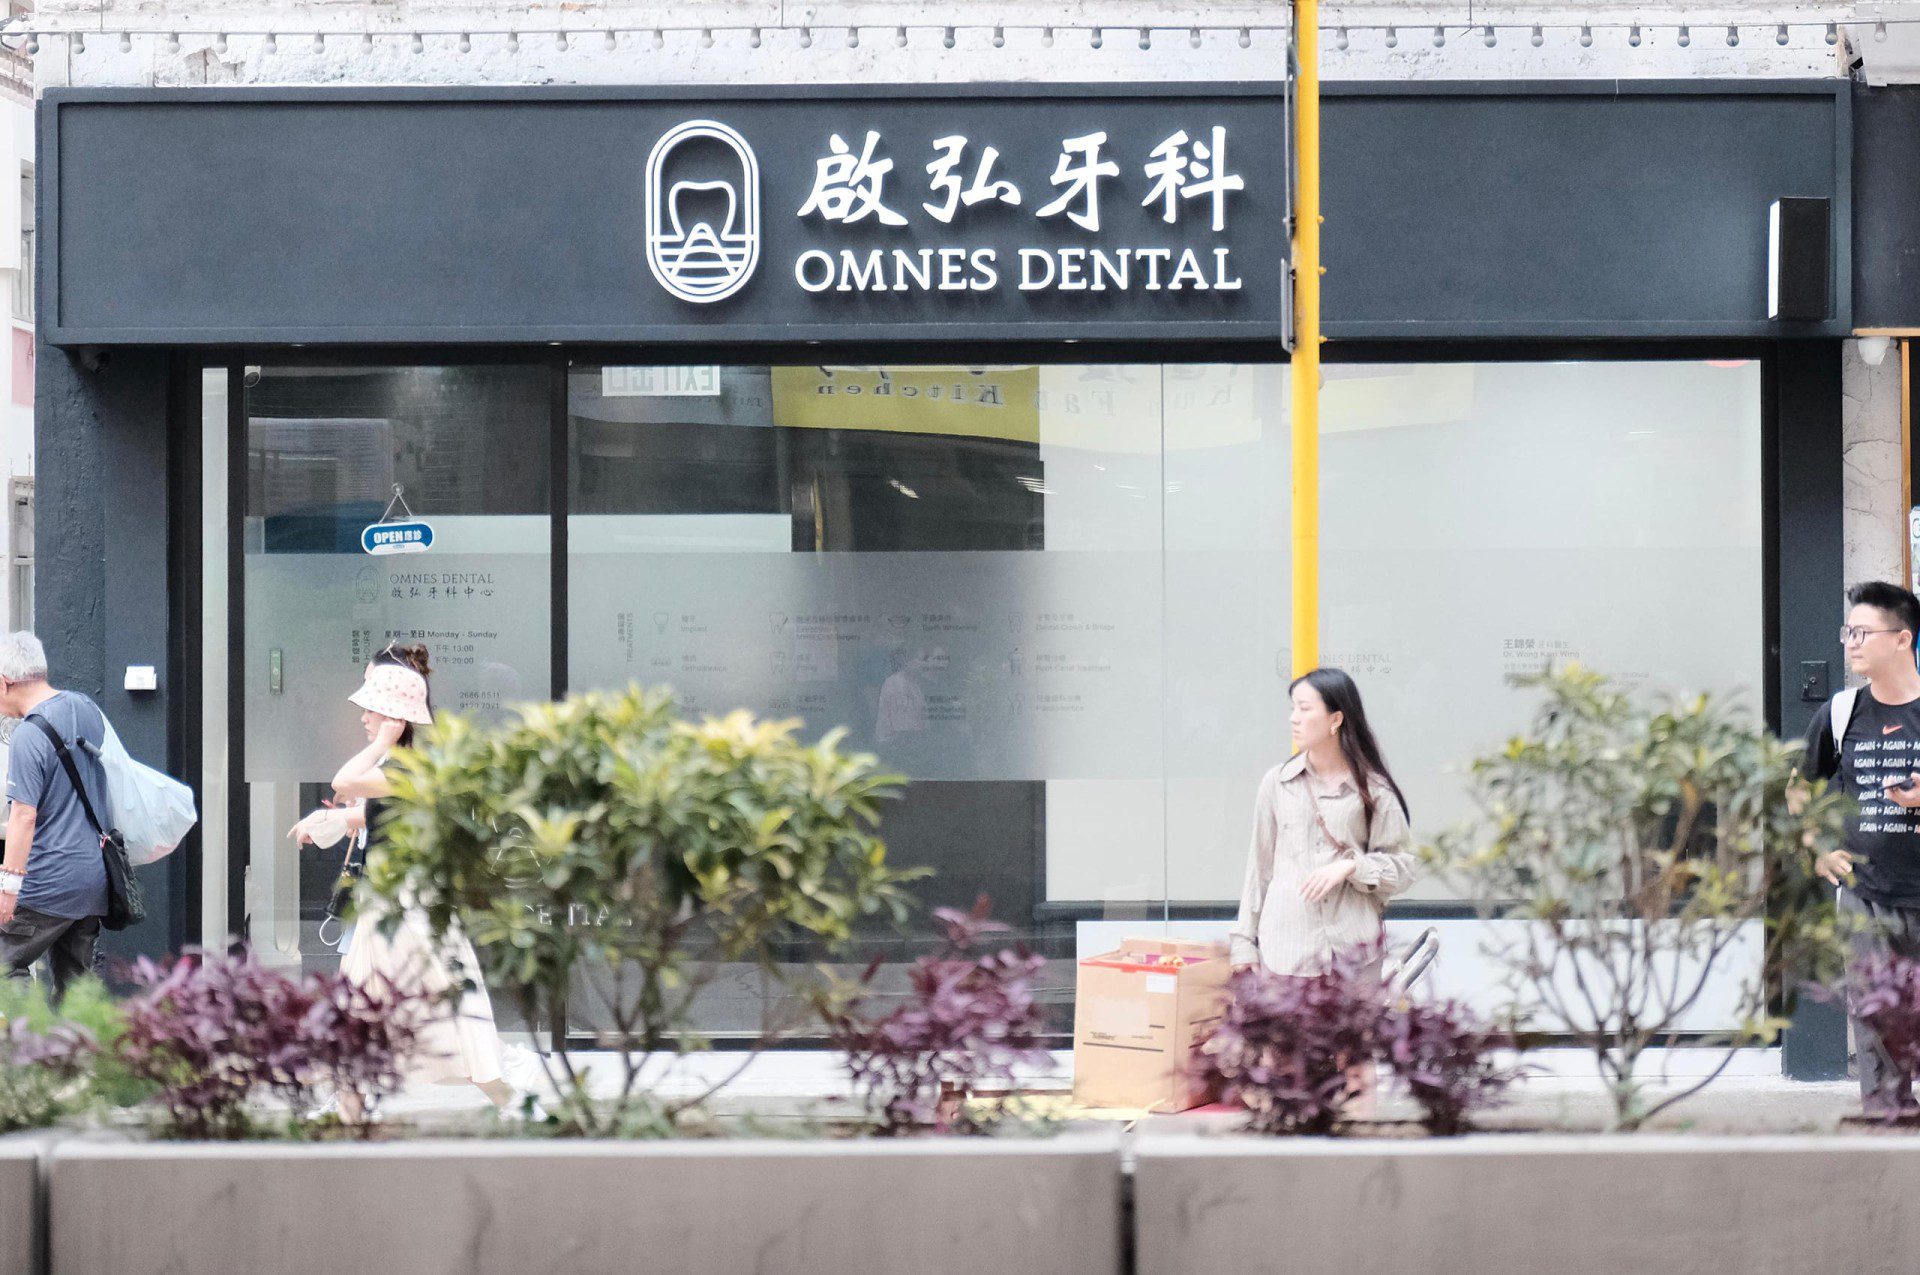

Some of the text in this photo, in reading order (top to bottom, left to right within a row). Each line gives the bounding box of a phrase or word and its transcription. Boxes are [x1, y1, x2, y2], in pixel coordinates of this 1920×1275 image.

[797, 126, 1244, 231] 啟弘牙科
[795, 249, 1241, 291] OMNES DENTAL
[373, 530, 404, 544] OPEN
[390, 573, 494, 584] OMNES DENTAL
[428, 631, 459, 639] Monday
[468, 631, 497, 639] Sunday
[453, 644, 474, 652] 13:00
[1348, 653, 1392, 663] DENTAL
[1503, 650, 1513, 658] Dr.
[1516, 650, 1538, 659] Wong
[1560, 650, 1580, 659] Wing
[452, 657, 474, 665] 20:00
[1854, 741, 1876, 752] AGAIN
[1882, 741, 1906, 750] AGAIN
[1854, 758, 1876, 768] AGAIN
[1882, 758, 1906, 768] AGAIN
[1883, 806, 1907, 815] AGAIN
[1883, 823, 1907, 832] AGAIN
